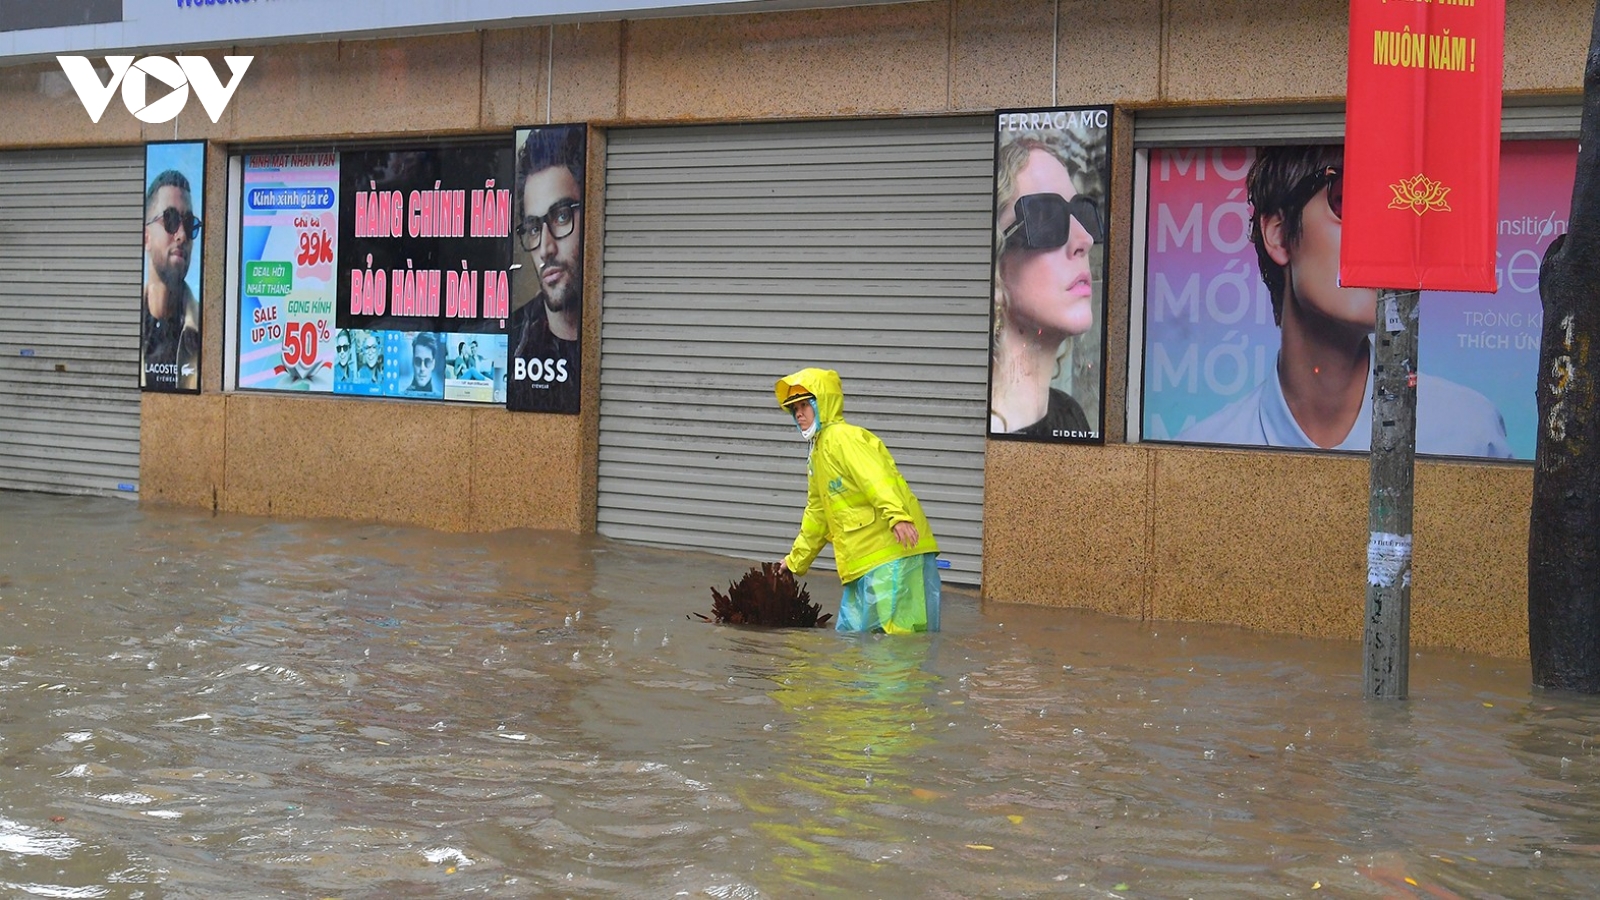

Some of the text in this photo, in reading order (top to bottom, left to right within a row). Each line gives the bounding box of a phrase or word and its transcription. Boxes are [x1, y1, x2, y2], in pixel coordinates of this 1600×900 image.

[1373, 25, 1425, 68] MUÔN
[1429, 28, 1466, 71] NĂM
[998, 110, 1108, 132] FERRAGAMO
[253, 190, 276, 206] Kính
[277, 190, 299, 206] xinh
[301, 190, 316, 209] giá
[355, 179, 512, 238] HÀNG CHÍNH HÃN
[297, 229, 334, 266] 99k
[252, 266, 270, 277] DEAL
[267, 281, 291, 295] THÁNG
[351, 253, 387, 316] BẢO
[391, 258, 441, 317] HÀNH
[446, 260, 478, 318] DÀI
[254, 306, 277, 323] SALE
[288, 298, 332, 316] GỌNG KÍNH
[1463, 309, 1522, 328] TRÒNG
[252, 325, 281, 342] UP TO
[283, 319, 330, 366] 50%
[1457, 330, 1509, 349] THÍCH
[145, 363, 178, 375] LACOSTE
[514, 357, 568, 383] BOSS
